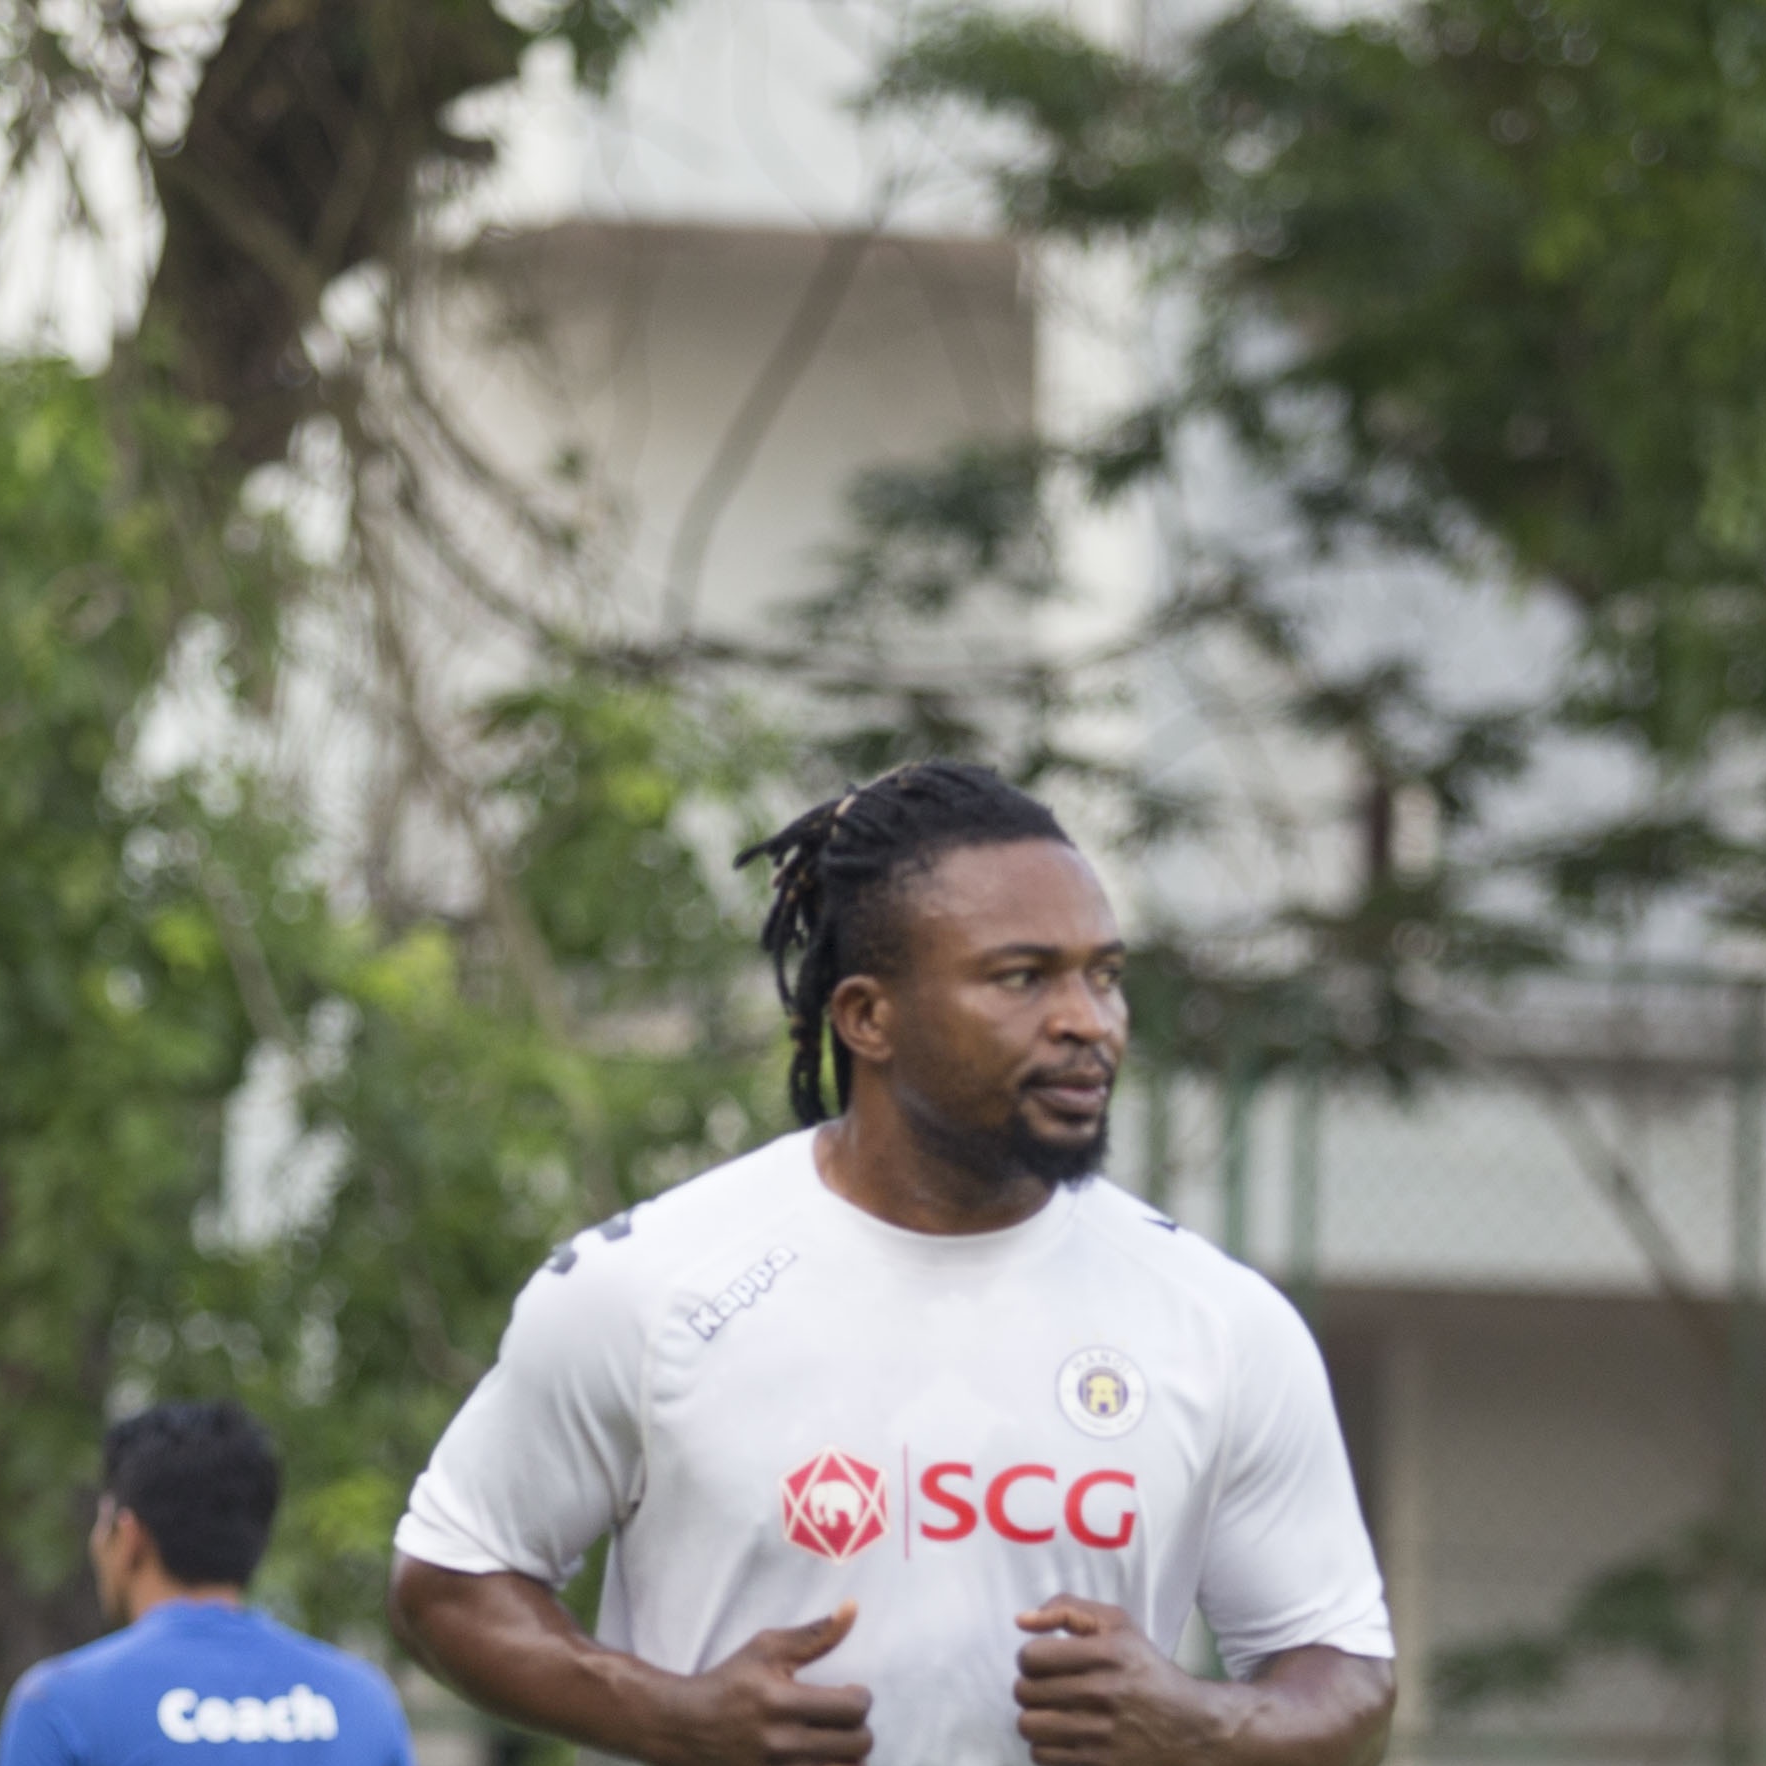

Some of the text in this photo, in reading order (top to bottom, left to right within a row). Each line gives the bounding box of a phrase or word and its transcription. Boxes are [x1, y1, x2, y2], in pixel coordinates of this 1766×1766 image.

[686, 1244, 799, 1341] Kappa
[919, 1461, 1136, 1551] SCG
[156, 1683, 339, 1744] Coach
